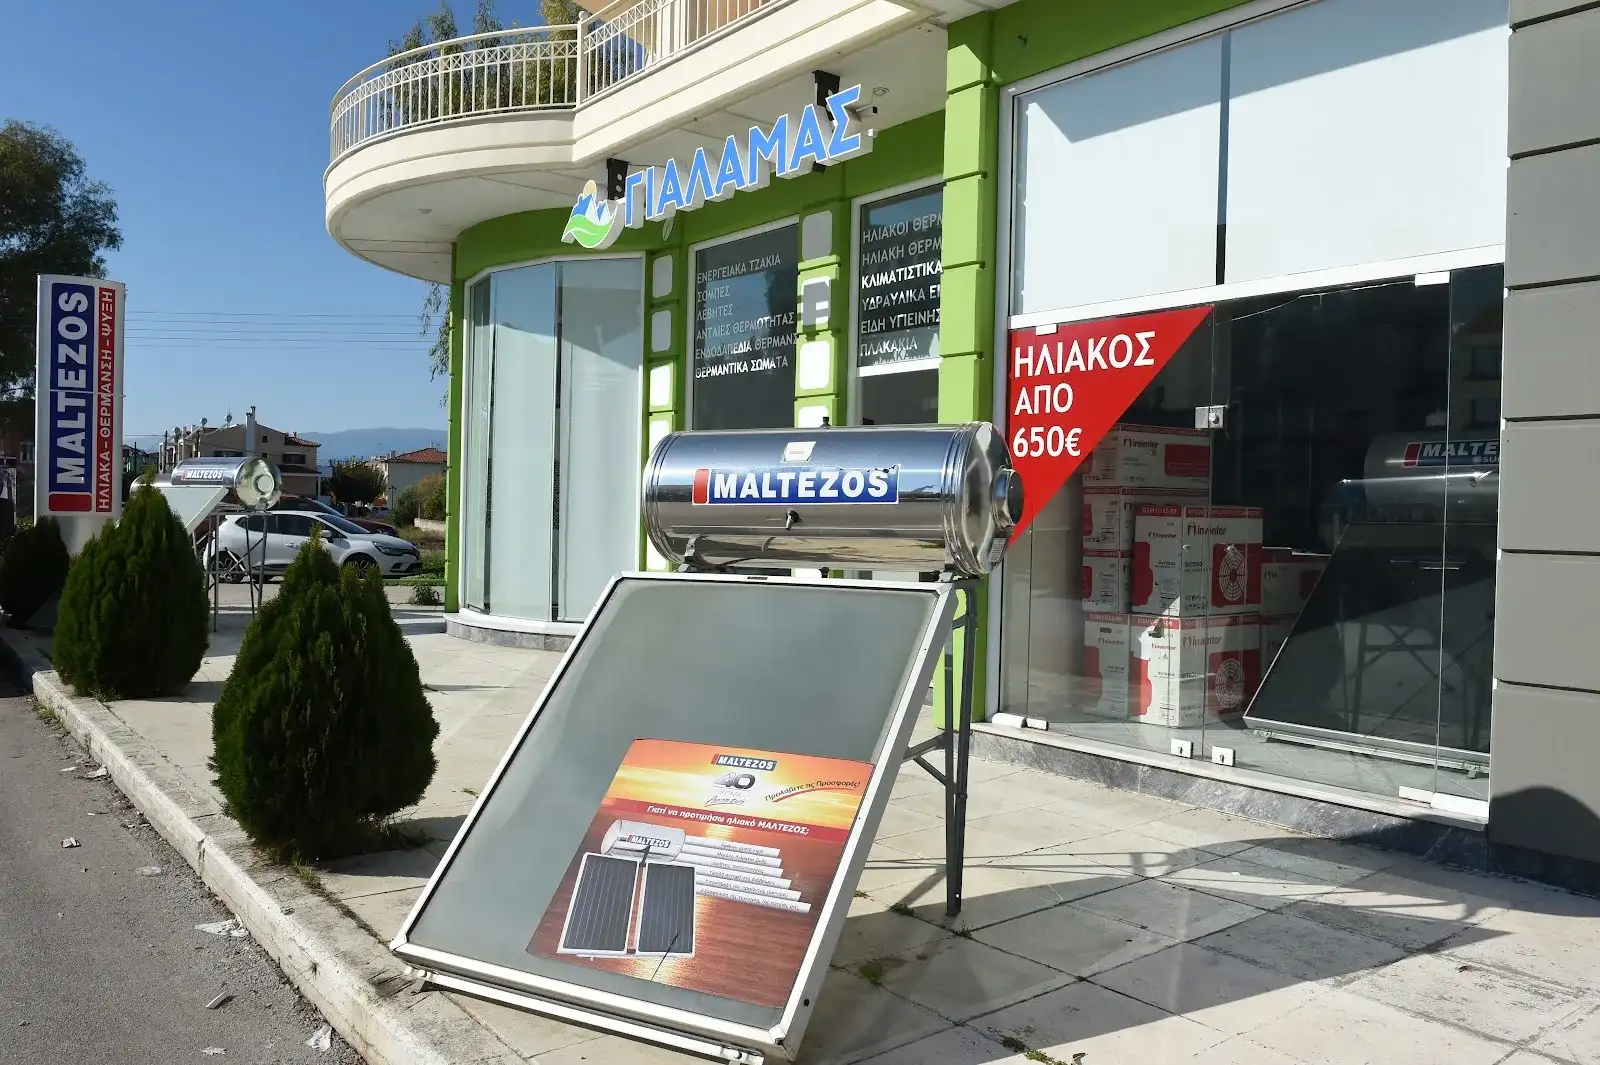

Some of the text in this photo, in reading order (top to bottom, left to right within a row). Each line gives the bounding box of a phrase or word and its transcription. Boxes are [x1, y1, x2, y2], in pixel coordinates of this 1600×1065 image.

[625, 84, 861, 226] ΓΙΑΛΑΜΑΣ
[863, 220, 908, 244] ΗΛΙΑΚΟΙ
[862, 244, 904, 266] ΗΛΙΑΚΗ
[698, 253, 782, 283] ΕΝΕΡΓΕΙΑΚΑ ΤΖΑΚΙΑ
[862, 260, 943, 290] ΚΛΙΜΑΤΙΣΤΙΚΑ
[698, 286, 730, 302] ΣΟΜΠΕΣ
[862, 287, 926, 311] ΥΔΡΑΥΛΙΚΑ
[102, 291, 113, 336] ΨΥΞΗ
[697, 304, 734, 321] ΛΕΒΗΤΕΣ
[696, 312, 794, 340] ΑΝΤΛΙΕΣ ΘΕΡΜΟΤΗΤΑΣ
[860, 318, 886, 334] ΕΙΔΗ
[696, 340, 752, 360] ΕΝΔΟΔΑΠΕΔΙΑ
[860, 336, 918, 356] ΠΛΑΚΑΚΙΑ
[1014, 331, 1156, 378] ΗΛΙΑΚΟΣ
[696, 356, 788, 378] ΘΕΡΜΑΝΤΙΚΑ ΣΩΜΑΤΑ
[57, 292, 88, 484] MALTEZOS
[100, 350, 112, 437] ΘΕΡΜΑΝΣΗ
[1014, 383, 1074, 416] ΑΠΟ
[1013, 426, 1082, 458] 650€
[1423, 442, 1499, 456] MALTE
[98, 452, 112, 508] ΗΛΙΑΚΑ
[186, 469, 223, 479] MALTEZOS
[714, 471, 889, 498] MALTEZOS
[718, 756, 774, 770] MALTEZOS
[765, 784, 804, 801] Προλάβετε
[816, 780, 860, 788] Προσφορές!
[647, 806, 810, 835] Γιατί να προτιμήσω ηλιακό ΜΑΛΤΕΖΟΣ;
[631, 835, 670, 848] MALTEZOS
